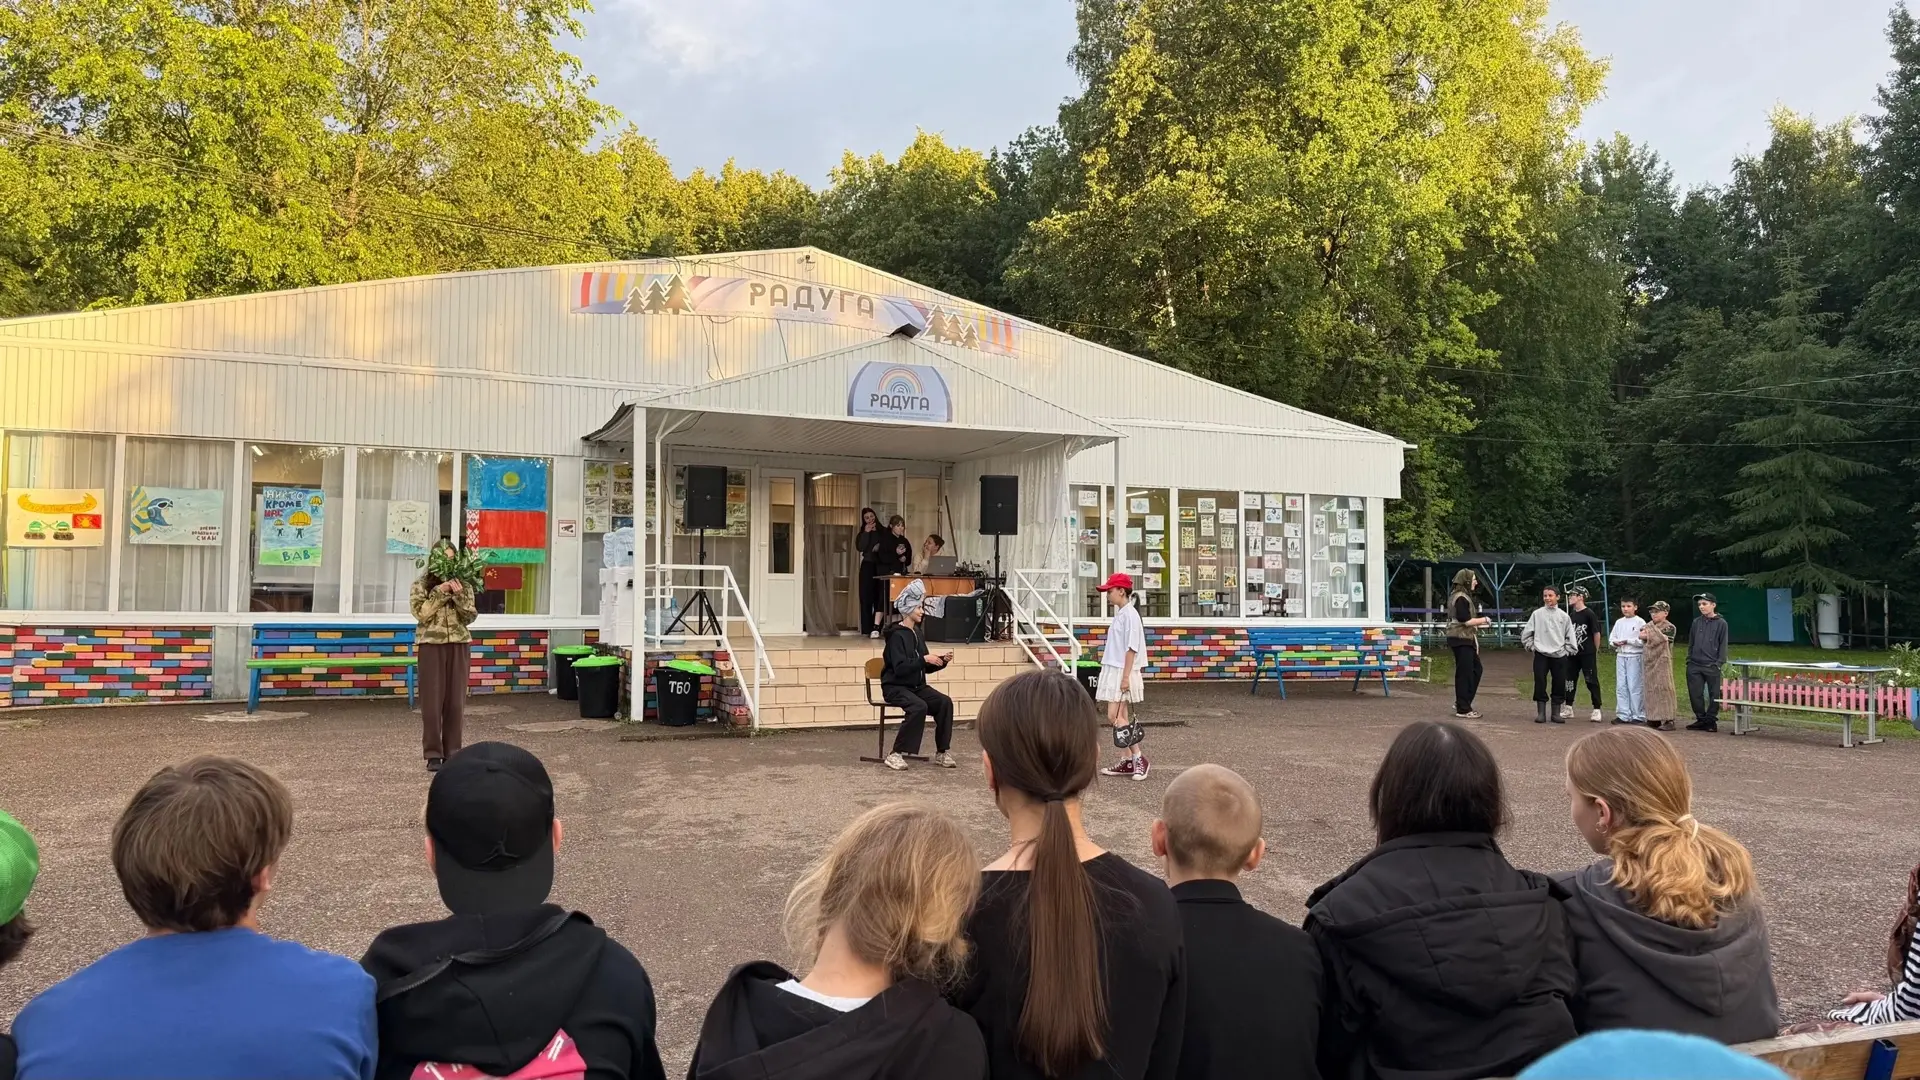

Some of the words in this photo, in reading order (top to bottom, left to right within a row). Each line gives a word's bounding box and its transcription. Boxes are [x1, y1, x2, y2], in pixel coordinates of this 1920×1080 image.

[750, 283, 875, 320] РАДУГА
[870, 394, 930, 411] РАДУГА
[266, 491, 304, 500] НИКТО
[265, 500, 302, 509] КРОМЕ
[668, 680, 691, 694] ТБО
[1088, 676, 1098, 688] ТБ
